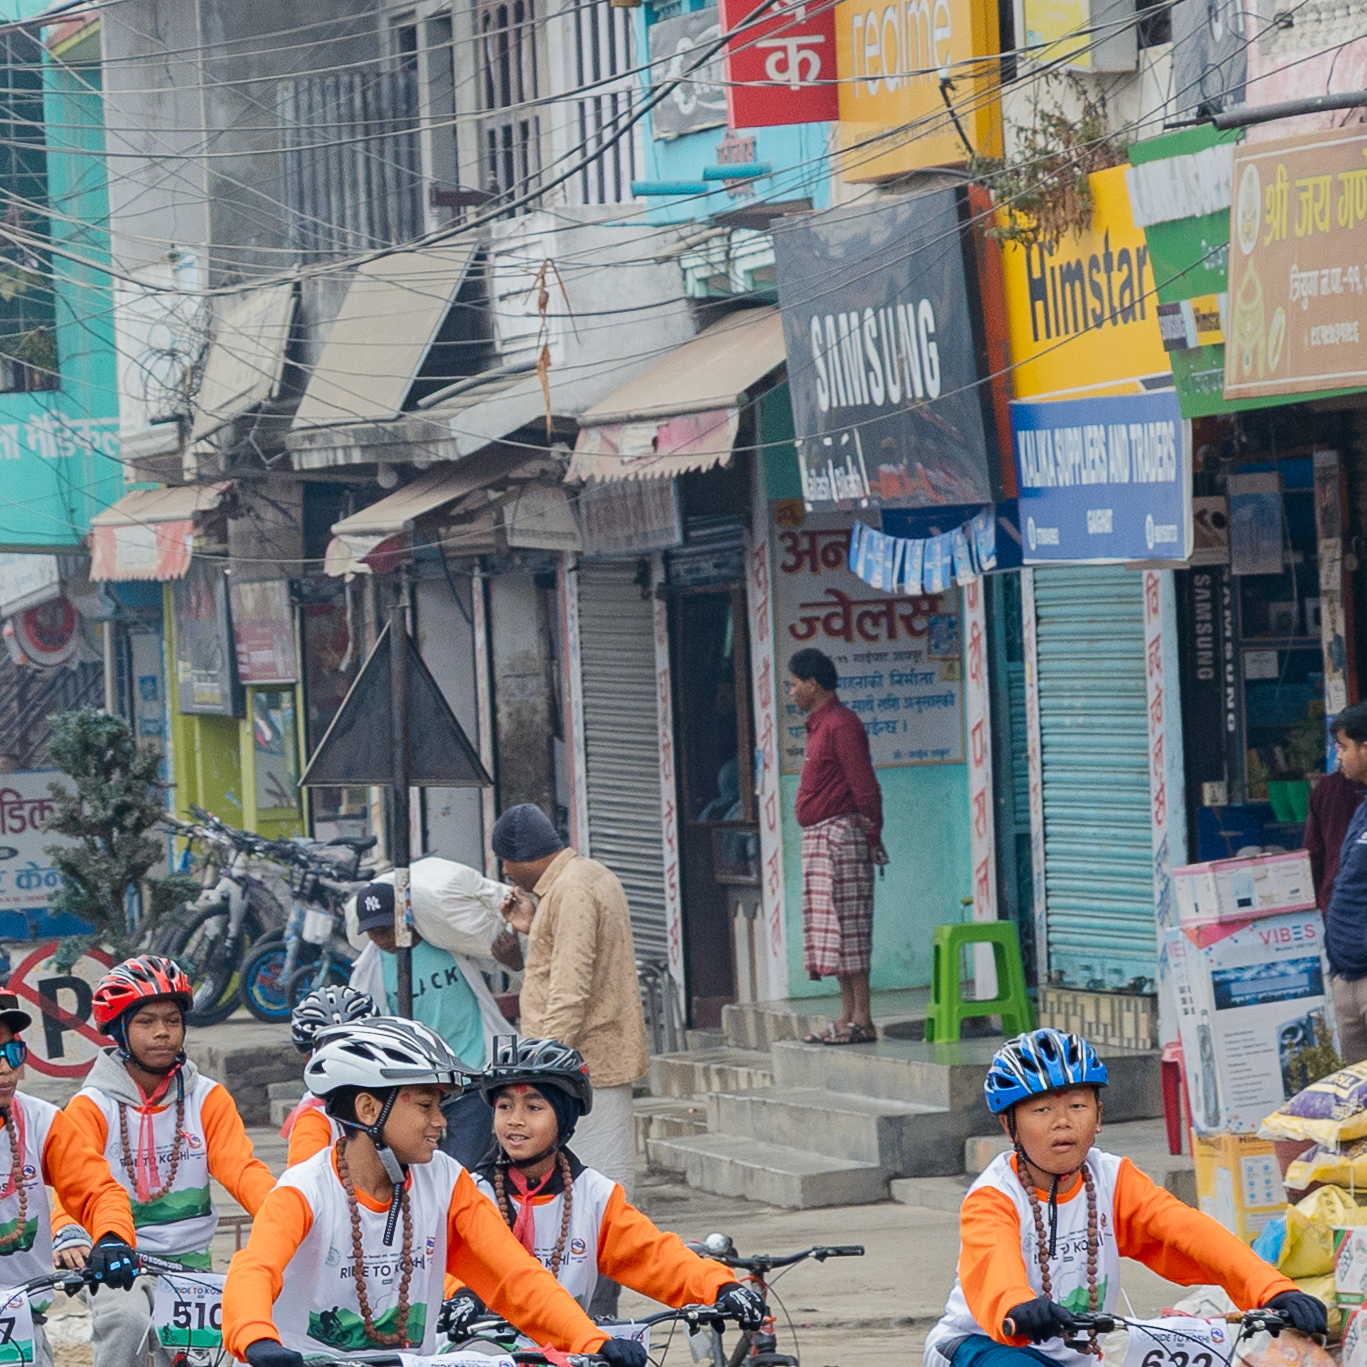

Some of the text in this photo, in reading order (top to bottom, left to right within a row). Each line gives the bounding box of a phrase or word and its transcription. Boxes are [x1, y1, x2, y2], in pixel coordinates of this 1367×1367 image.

[755, 35, 825, 91] क
[851, 0, 952, 98] realme
[1263, 163, 1290, 247] श्री
[1295, 174, 1333, 239] जय
[1025, 227, 1148, 343] Himstar
[811, 298, 941, 412] SAMSUNG
[1257, 923, 1318, 947] VIBES
[37, 976, 93, 1060] P
[372, 1265, 391, 1278] TO
